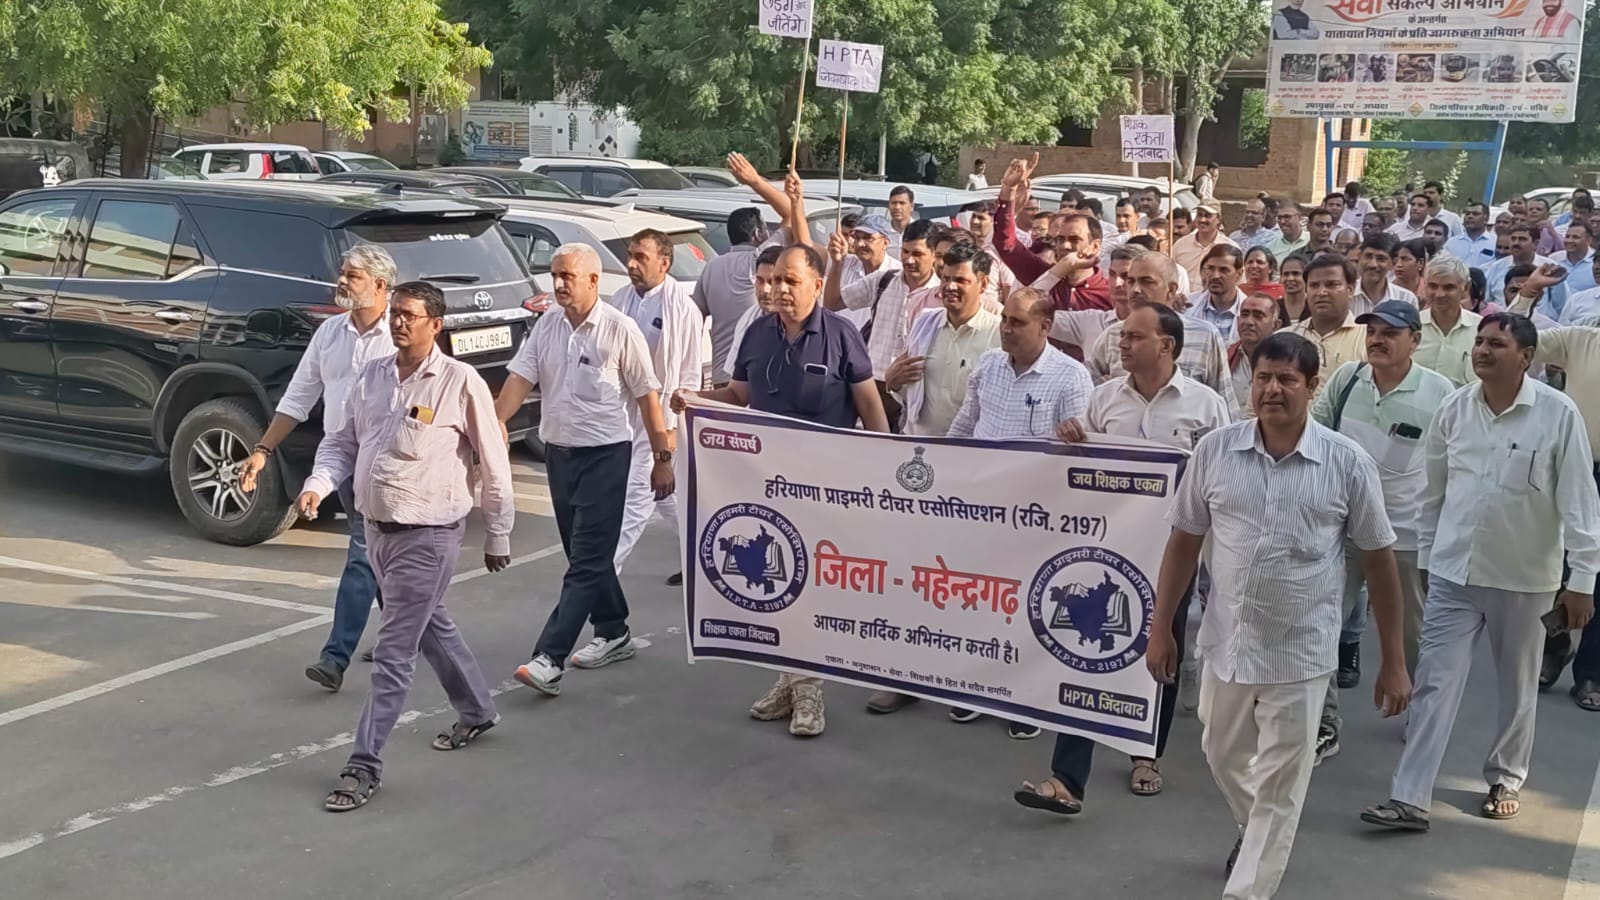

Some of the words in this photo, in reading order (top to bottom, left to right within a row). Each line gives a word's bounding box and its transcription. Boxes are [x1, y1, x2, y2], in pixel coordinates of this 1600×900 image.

[1324, 29, 1364, 39] यातायात
[1409, 27, 1427, 38] प्रति
[1482, 27, 1526, 37] अभियान
[703, 432, 726, 447] जय
[728, 433, 759, 452] संघर्ष
[1072, 471, 1092, 487] जय
[1095, 470, 1131, 490] शिक्षक
[1134, 476, 1165, 493] एकता
[765, 475, 820, 502] हरियाणा
[825, 486, 874, 509] प्राइमरी
[878, 489, 914, 514] टीचर
[919, 495, 1007, 525] एसोसिएशन
[1012, 502, 1055, 532] (रजि.
[1060, 514, 1107, 542] 2197)
[813, 539, 888, 595] जिला
[912, 555, 1022, 625] महेन्द्रगढ़
[703, 621, 728, 636] शिक्षक
[728, 624, 747, 638] एकता
[814, 614, 855, 636] आपका
[860, 617, 900, 642] हार्दिक
[905, 625, 962, 653] अभिनंदन
[966, 637, 1000, 660] करती
[1063, 687, 1095, 709] HPTA
[1098, 691, 1145, 718] जिंदाबाद
